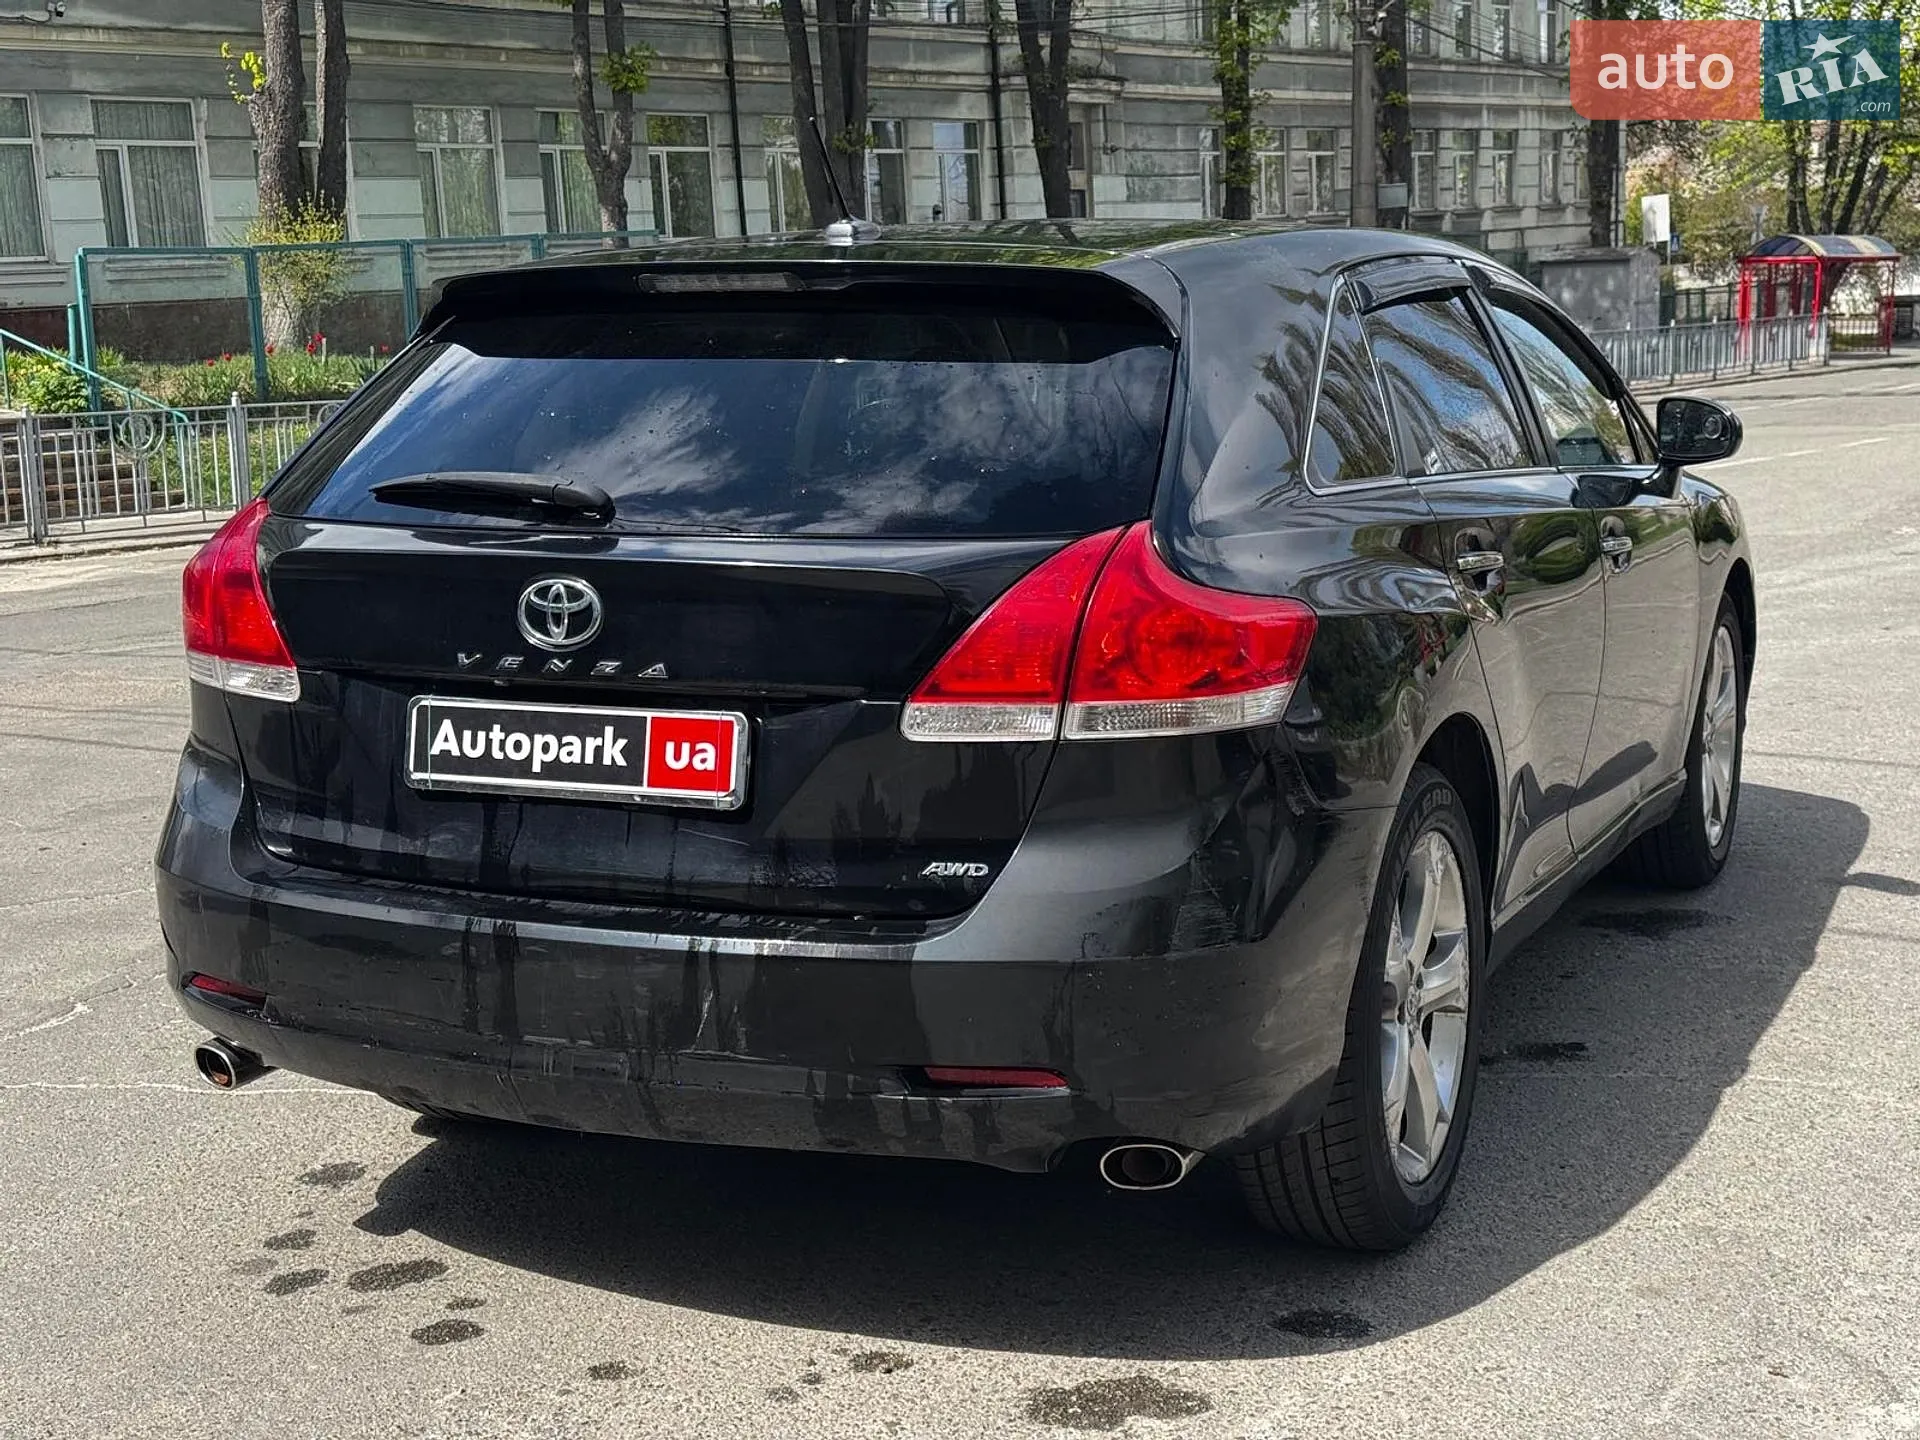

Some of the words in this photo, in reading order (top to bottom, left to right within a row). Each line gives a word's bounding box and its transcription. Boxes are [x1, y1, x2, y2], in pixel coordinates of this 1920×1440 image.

[456, 652, 669, 678] VENZA
[430, 719, 628, 773] Autopark
[665, 740, 717, 771] ua
[921, 862, 989, 876] AWD
